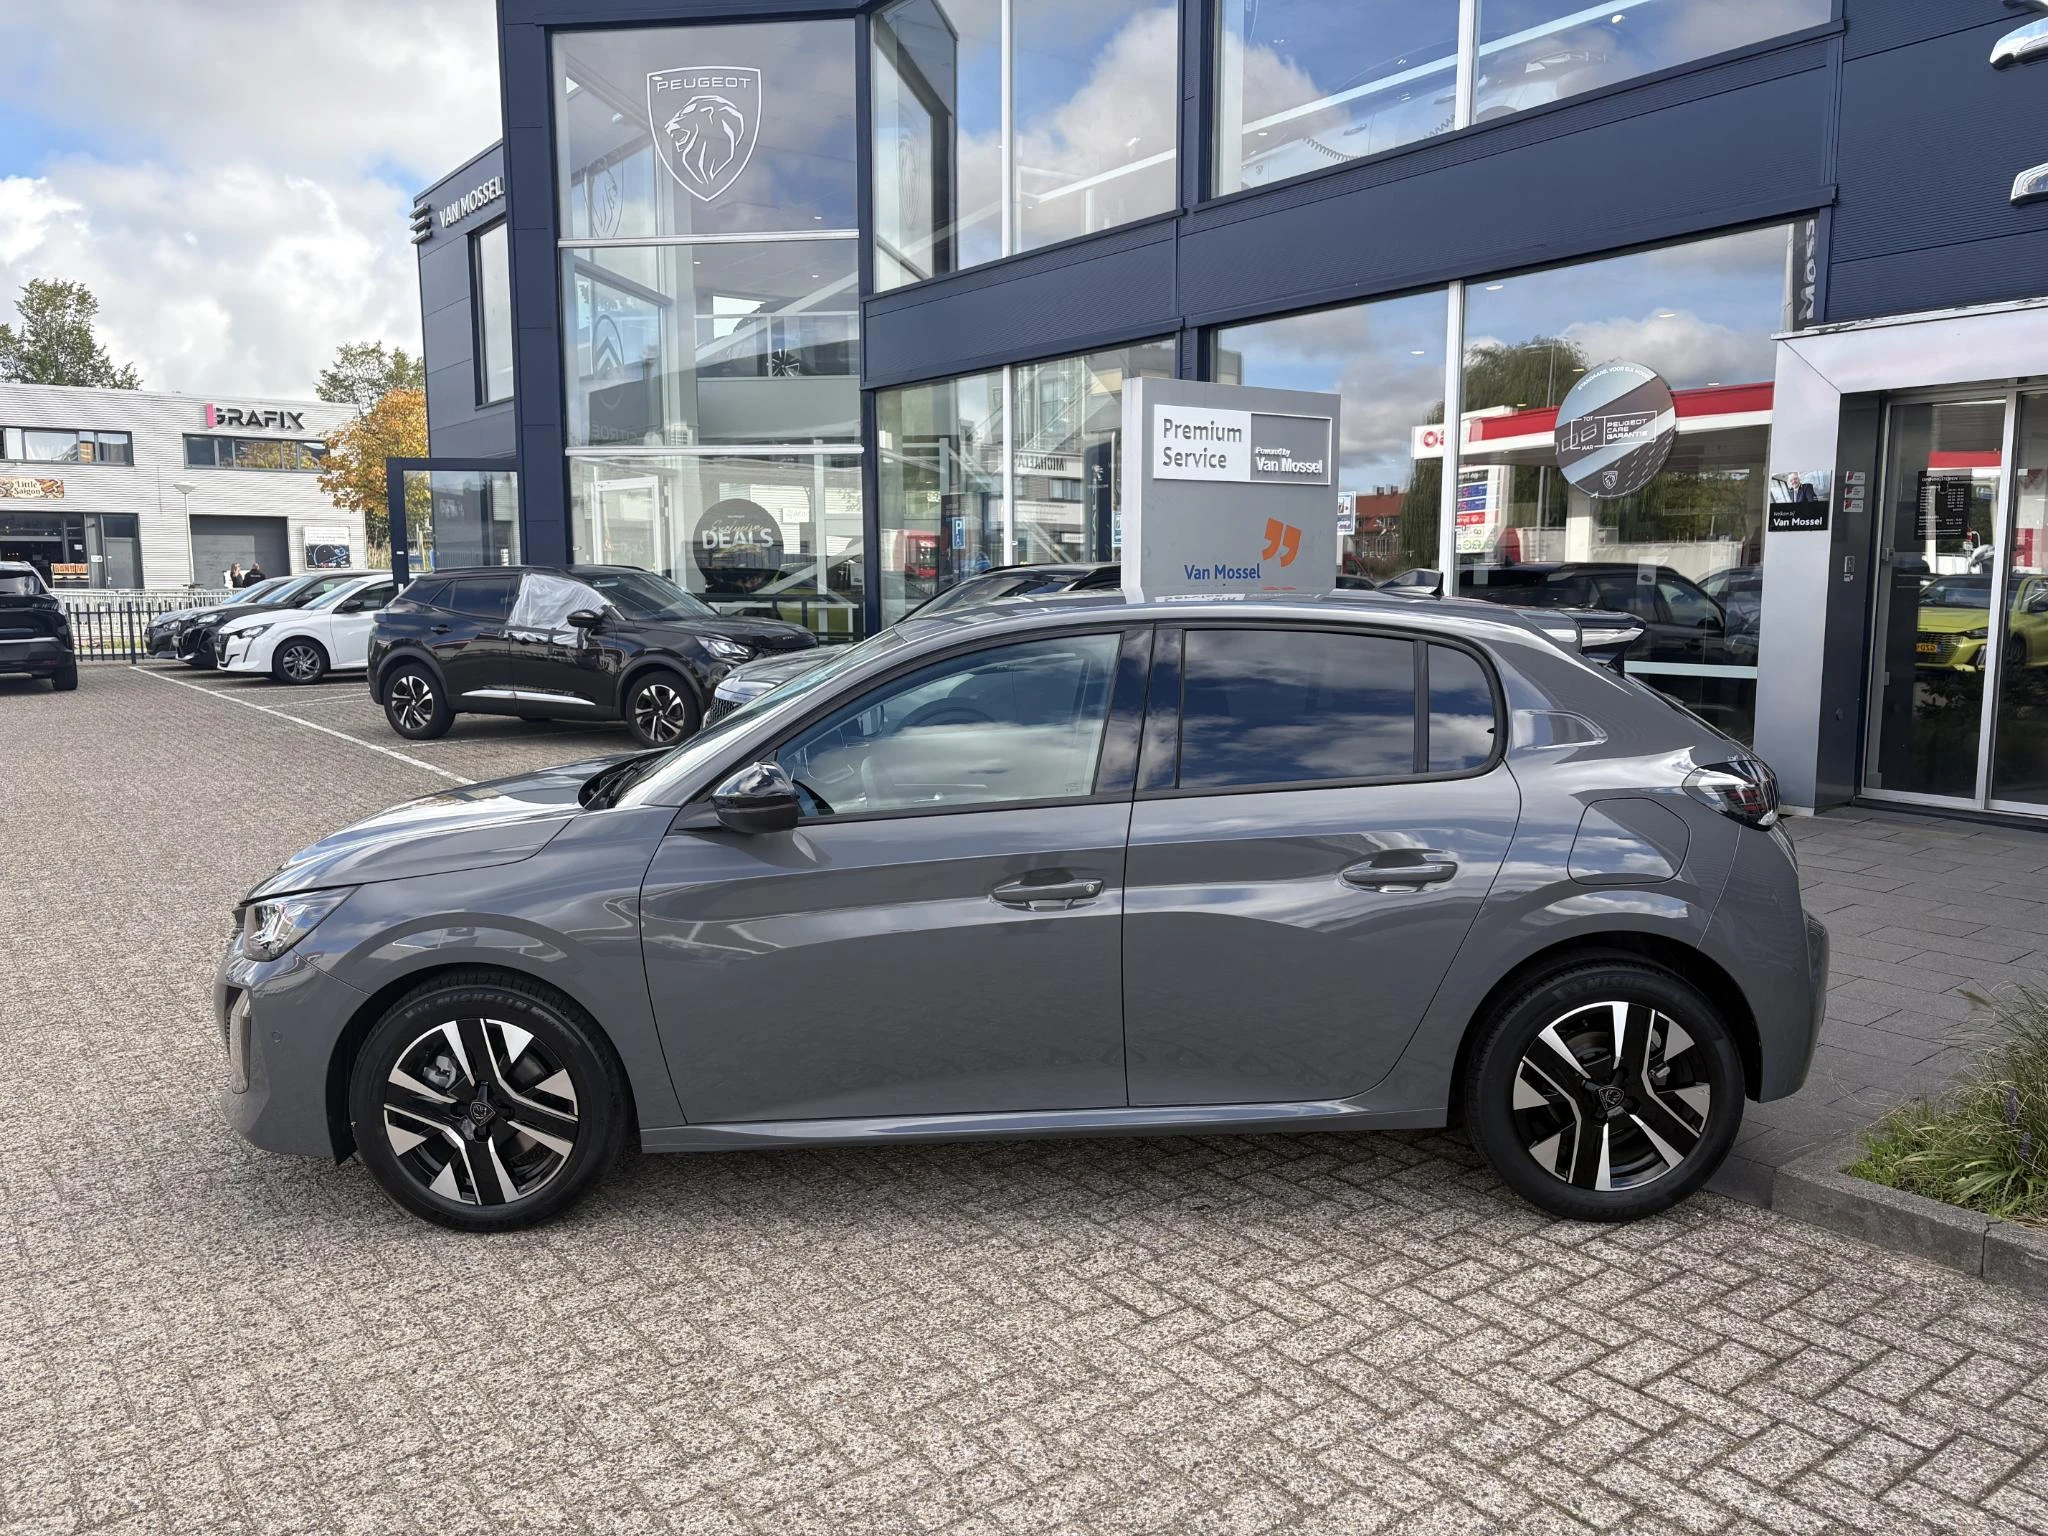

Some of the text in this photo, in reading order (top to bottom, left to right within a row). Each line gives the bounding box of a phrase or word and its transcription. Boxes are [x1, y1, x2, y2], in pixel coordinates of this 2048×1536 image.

[656, 77, 752, 92] PEUGEOT
[439, 176, 505, 228] VAN MOSSEL
[208, 404, 305, 430] GRAFIX
[1606, 419, 1648, 427] PEUGEOT
[1163, 418, 1242, 443] Premium
[1606, 431, 1649, 440] GARANTIE
[1162, 446, 1227, 469] Service
[1255, 456, 1323, 473] Van Mossel
[1773, 516, 1823, 526] Van Mossel
[702, 527, 774, 549] DEALS
[1184, 563, 1261, 580] Van Mossel
